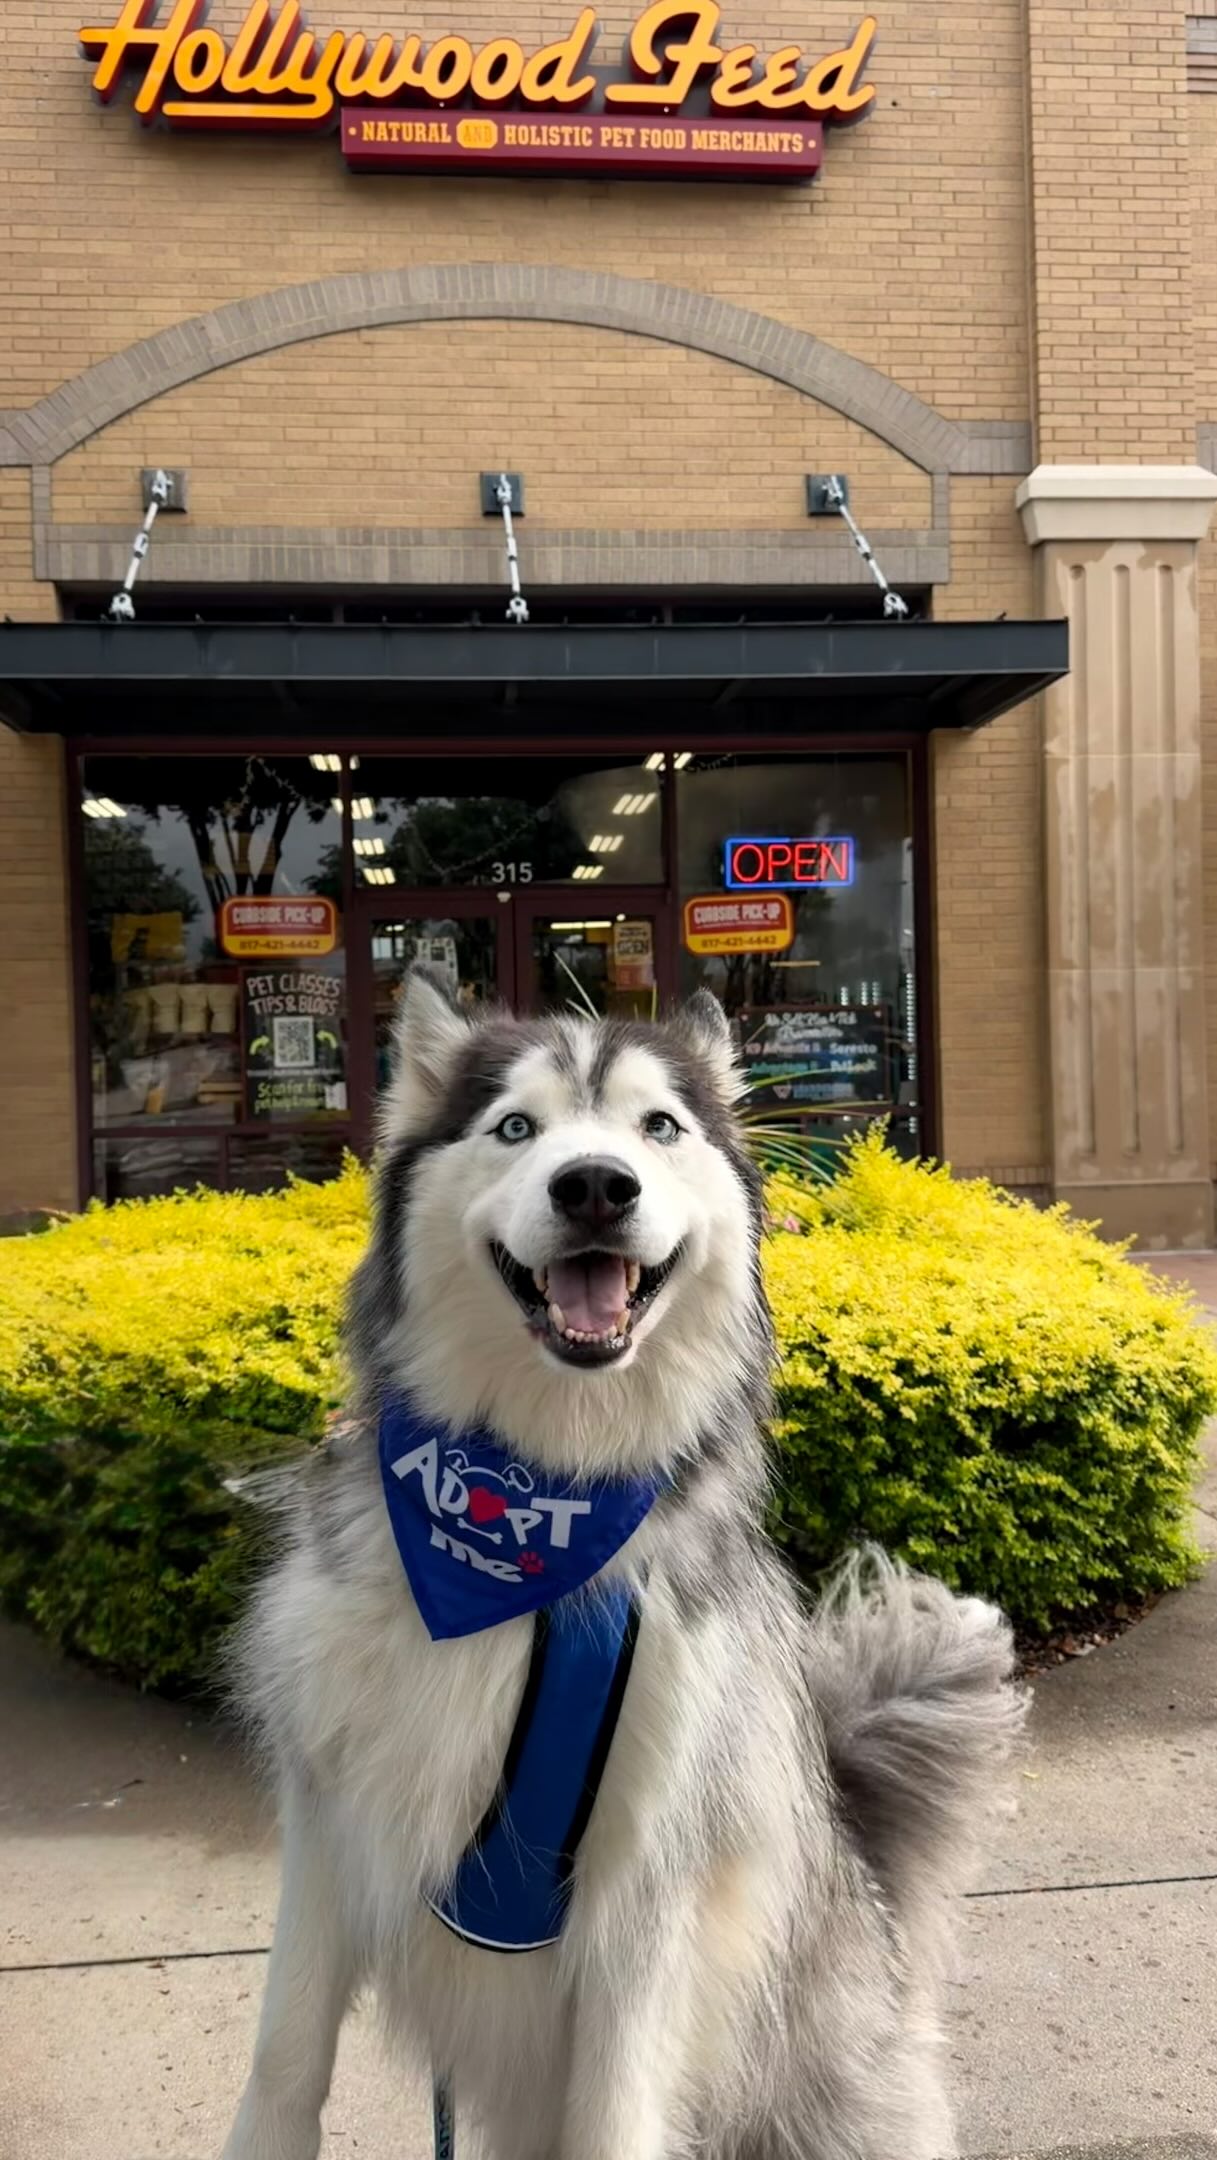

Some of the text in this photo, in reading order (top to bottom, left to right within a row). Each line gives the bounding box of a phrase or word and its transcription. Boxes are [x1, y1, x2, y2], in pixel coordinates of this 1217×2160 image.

[79, 0, 877, 119] Hollywood Feed
[362, 121, 804, 153] NATURAL AND HOLISTIC PET FOOD MERCHANTS
[491, 861, 533, 883] 315
[733, 843, 848, 882] OPEN
[232, 906, 326, 924] CURBSIDE PICK-UP
[694, 902, 781, 924] CURBSIDE PICK-UP
[246, 974, 341, 998] PET CLASSES
[248, 998, 284, 1015] TIPS
[299, 995, 339, 1016] BLOGS
